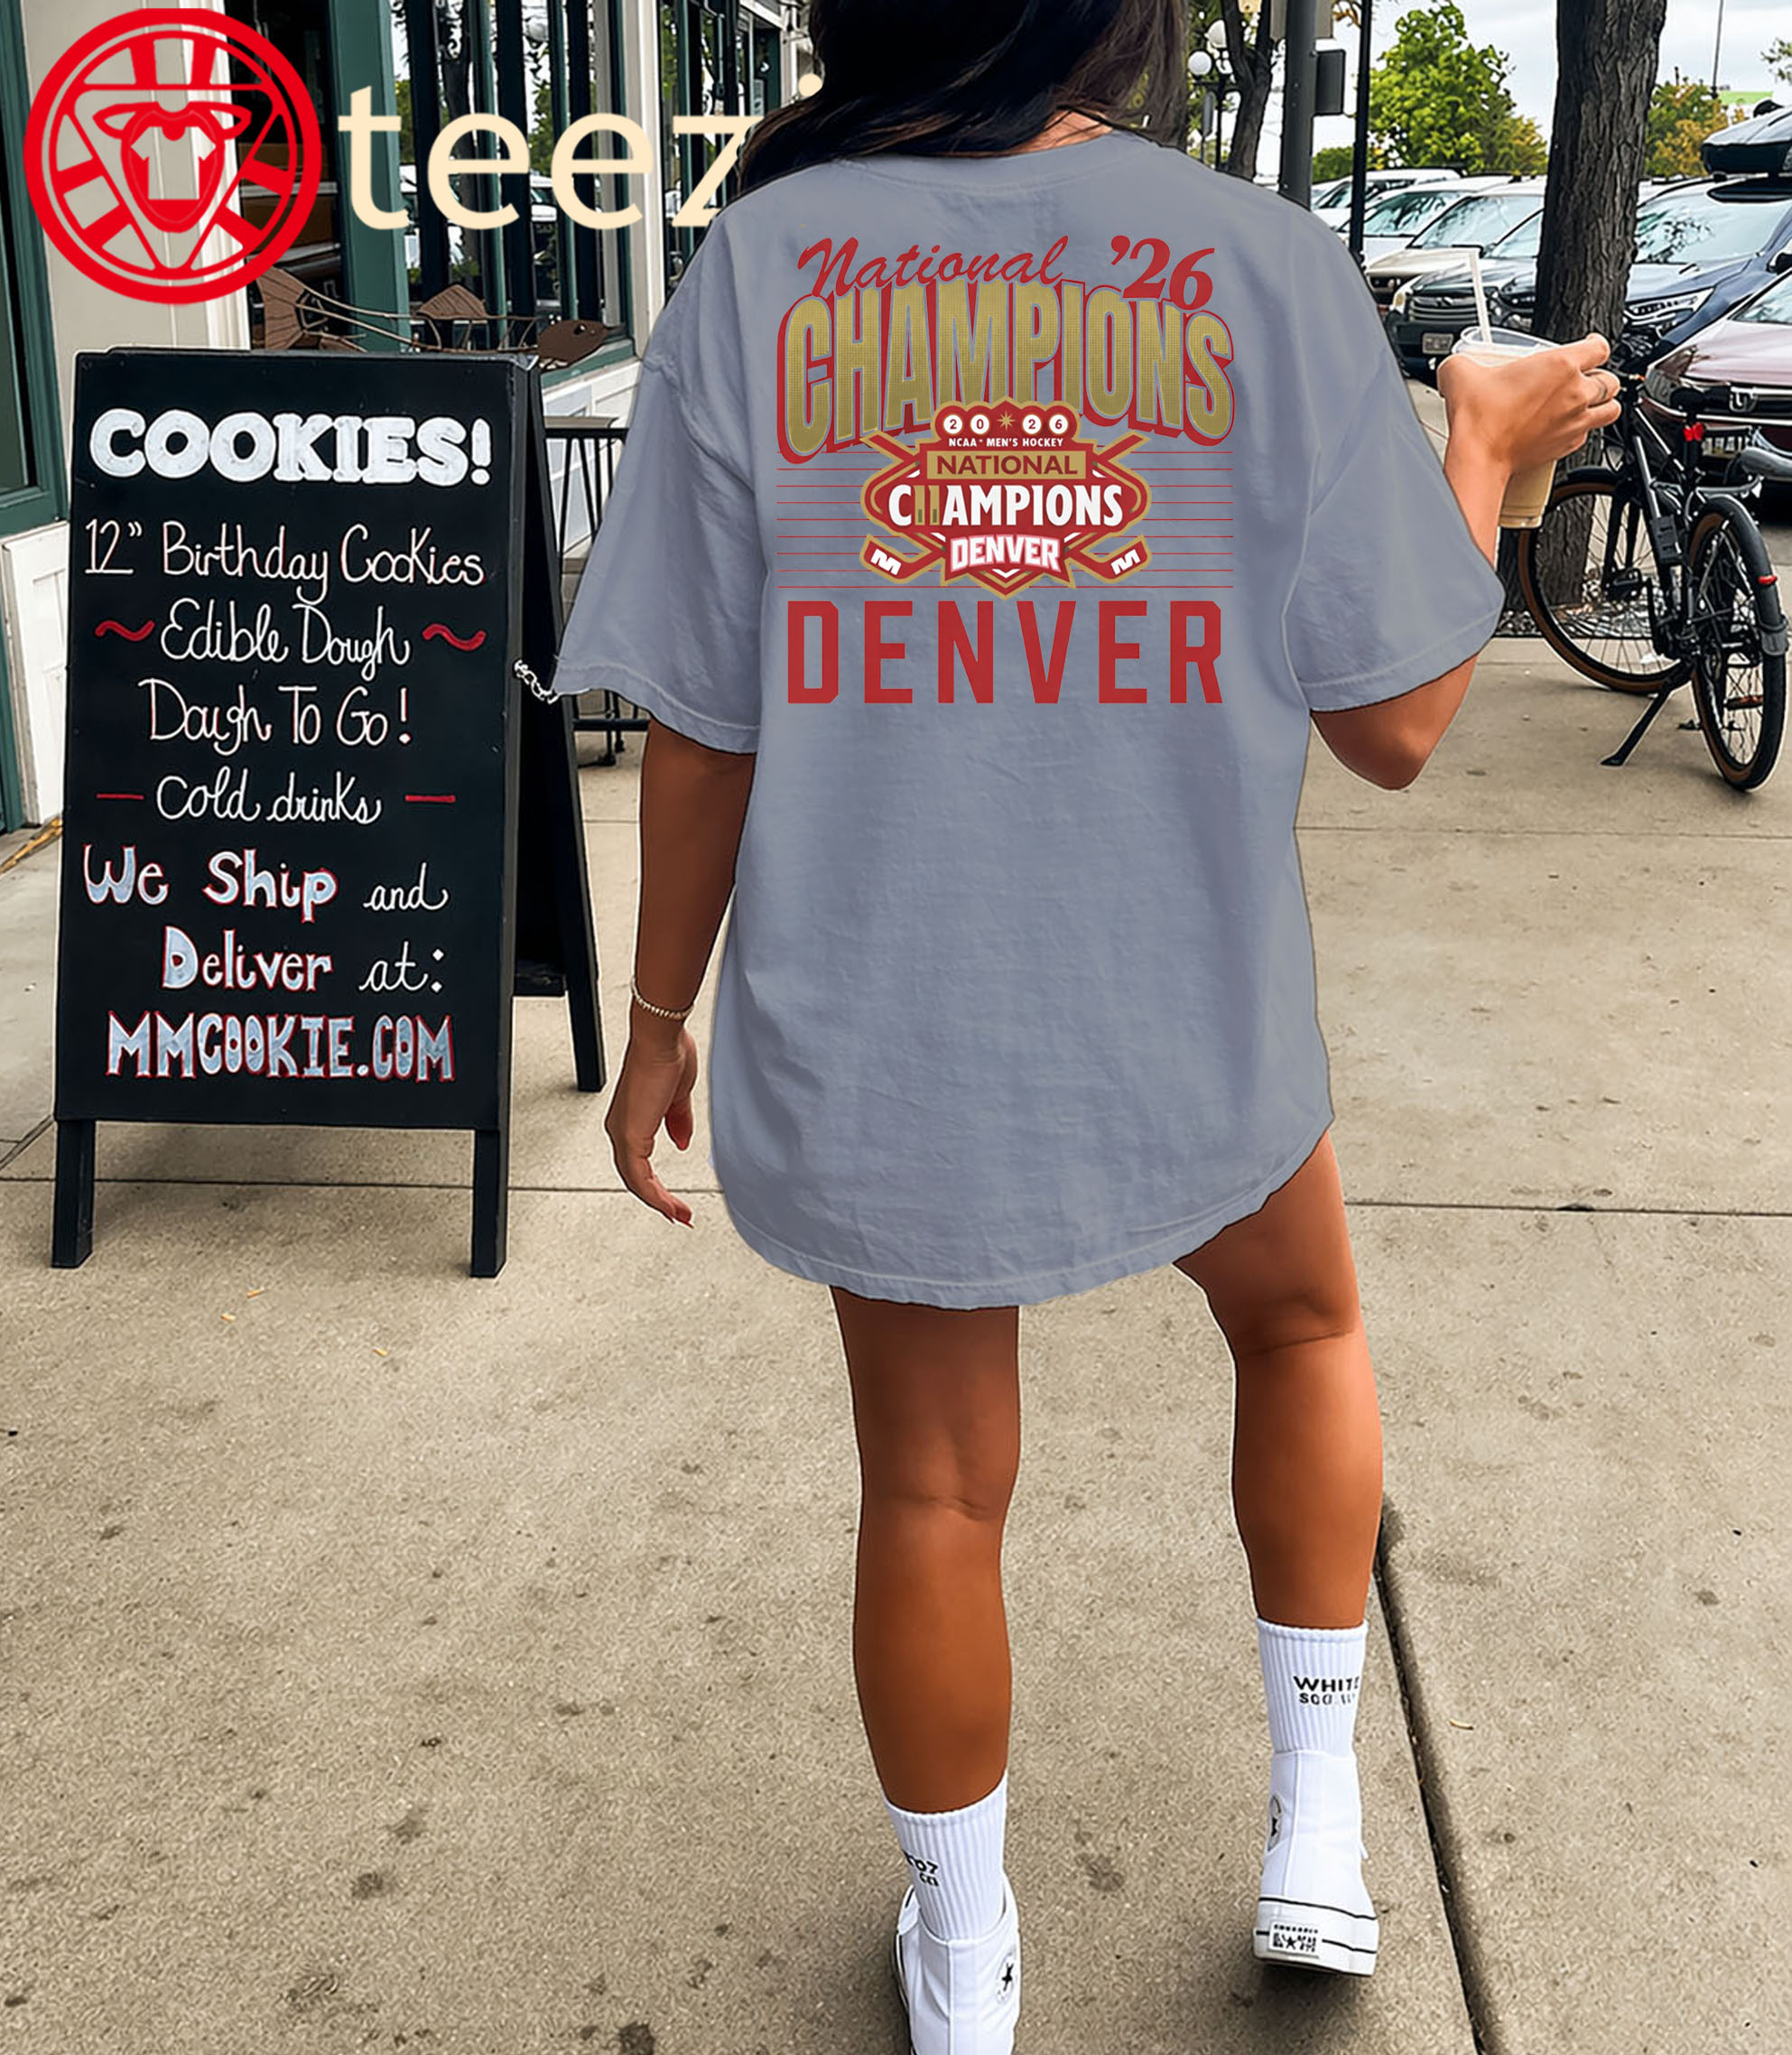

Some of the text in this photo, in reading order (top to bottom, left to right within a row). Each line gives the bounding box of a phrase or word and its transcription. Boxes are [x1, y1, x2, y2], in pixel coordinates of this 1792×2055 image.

[797, 236, 1215, 311] National '26
[776, 279, 1235, 464] CHAMPIONS
[89, 408, 492, 487] COOKIES!
[937, 455, 1078, 475] NATIONAL
[986, 438, 1018, 447] MEN'S
[1022, 438, 1063, 447] HOCKEY
[162, 521, 329, 606] Birthday
[951, 534, 1061, 572] DENVER
[161, 598, 411, 682] Edible Dough
[787, 600, 1223, 704] DENVER
[138, 678, 272, 756] Dough
[278, 685, 321, 745] To
[156, 766, 261, 822] Cold
[83, 844, 449, 923] We Ship and
[162, 925, 333, 991] Deliver
[105, 1010, 455, 1082] MMCOOKIE.COM
